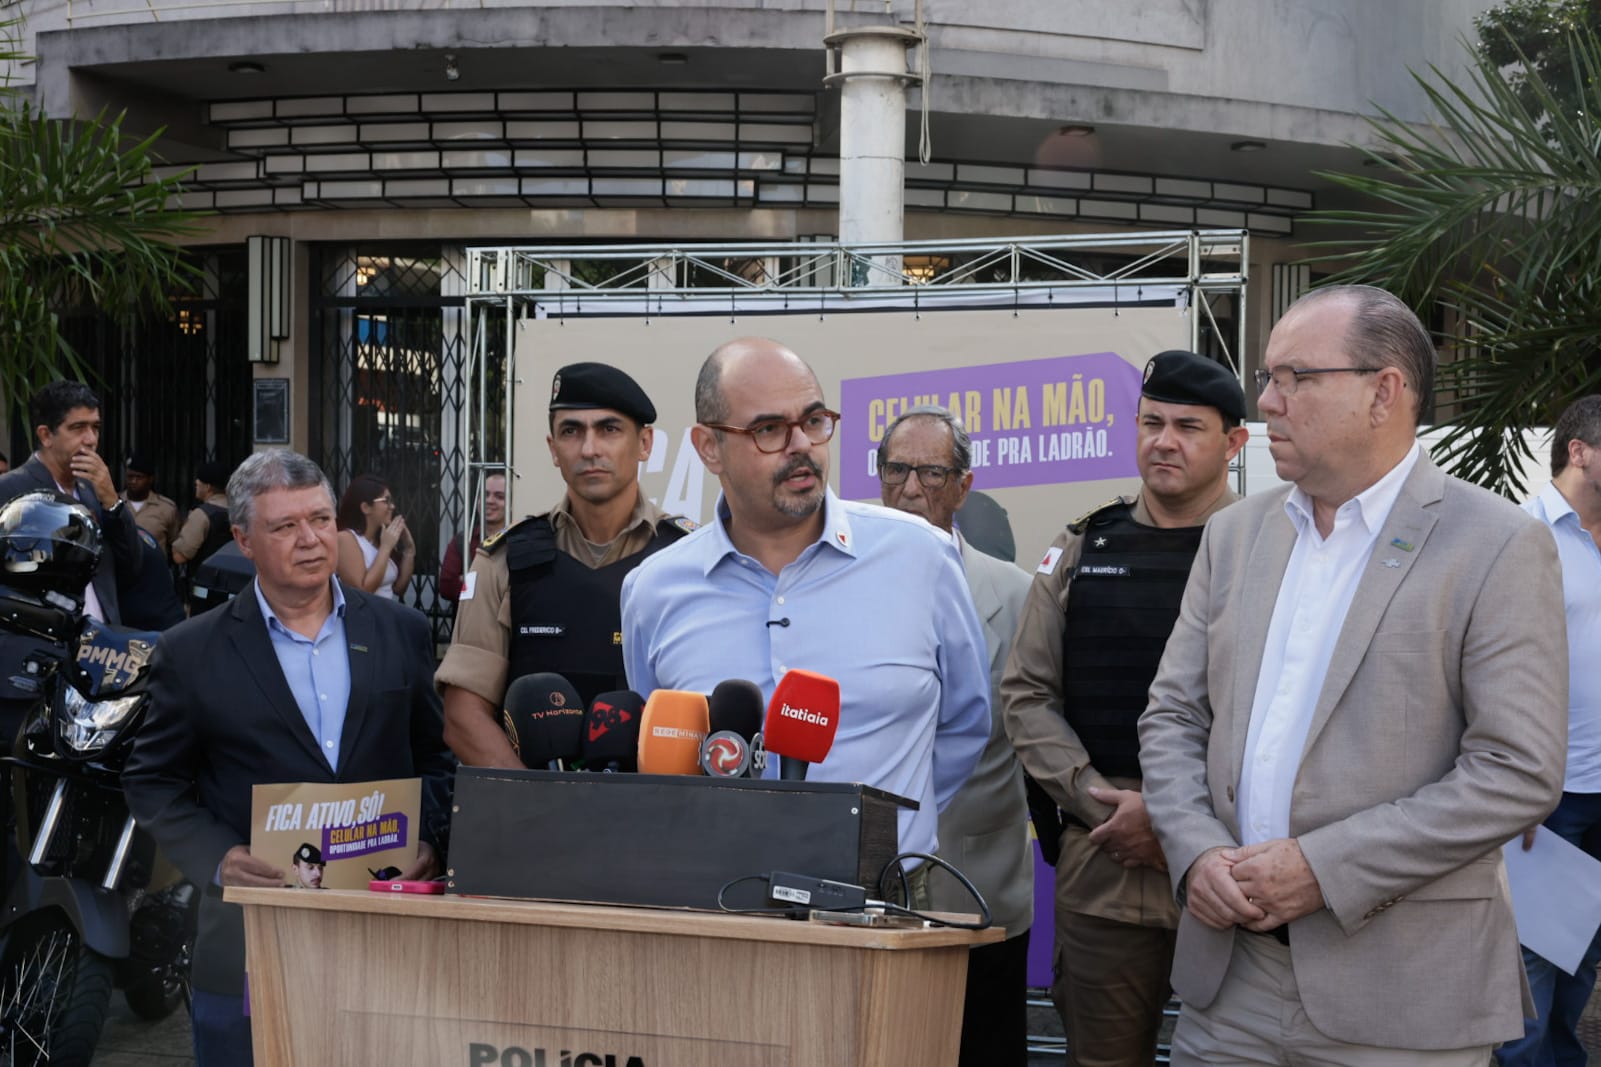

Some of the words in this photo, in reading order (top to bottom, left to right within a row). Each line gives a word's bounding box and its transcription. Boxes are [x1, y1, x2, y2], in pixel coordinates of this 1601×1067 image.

[868, 390, 981, 442] CEAR
[993, 386, 1031, 431] NA
[1042, 374, 1115, 427] MÃO,
[997, 436, 1032, 465] PRA
[1038, 426, 1113, 462] LADRÃO.
[76, 644, 140, 673] PMMG
[780, 703, 829, 727] itatiaia
[265, 803, 303, 832] FICA
[305, 799, 357, 831] ATIVO,
[330, 826, 365, 844] CELULAR
[367, 823, 378, 837] NA
